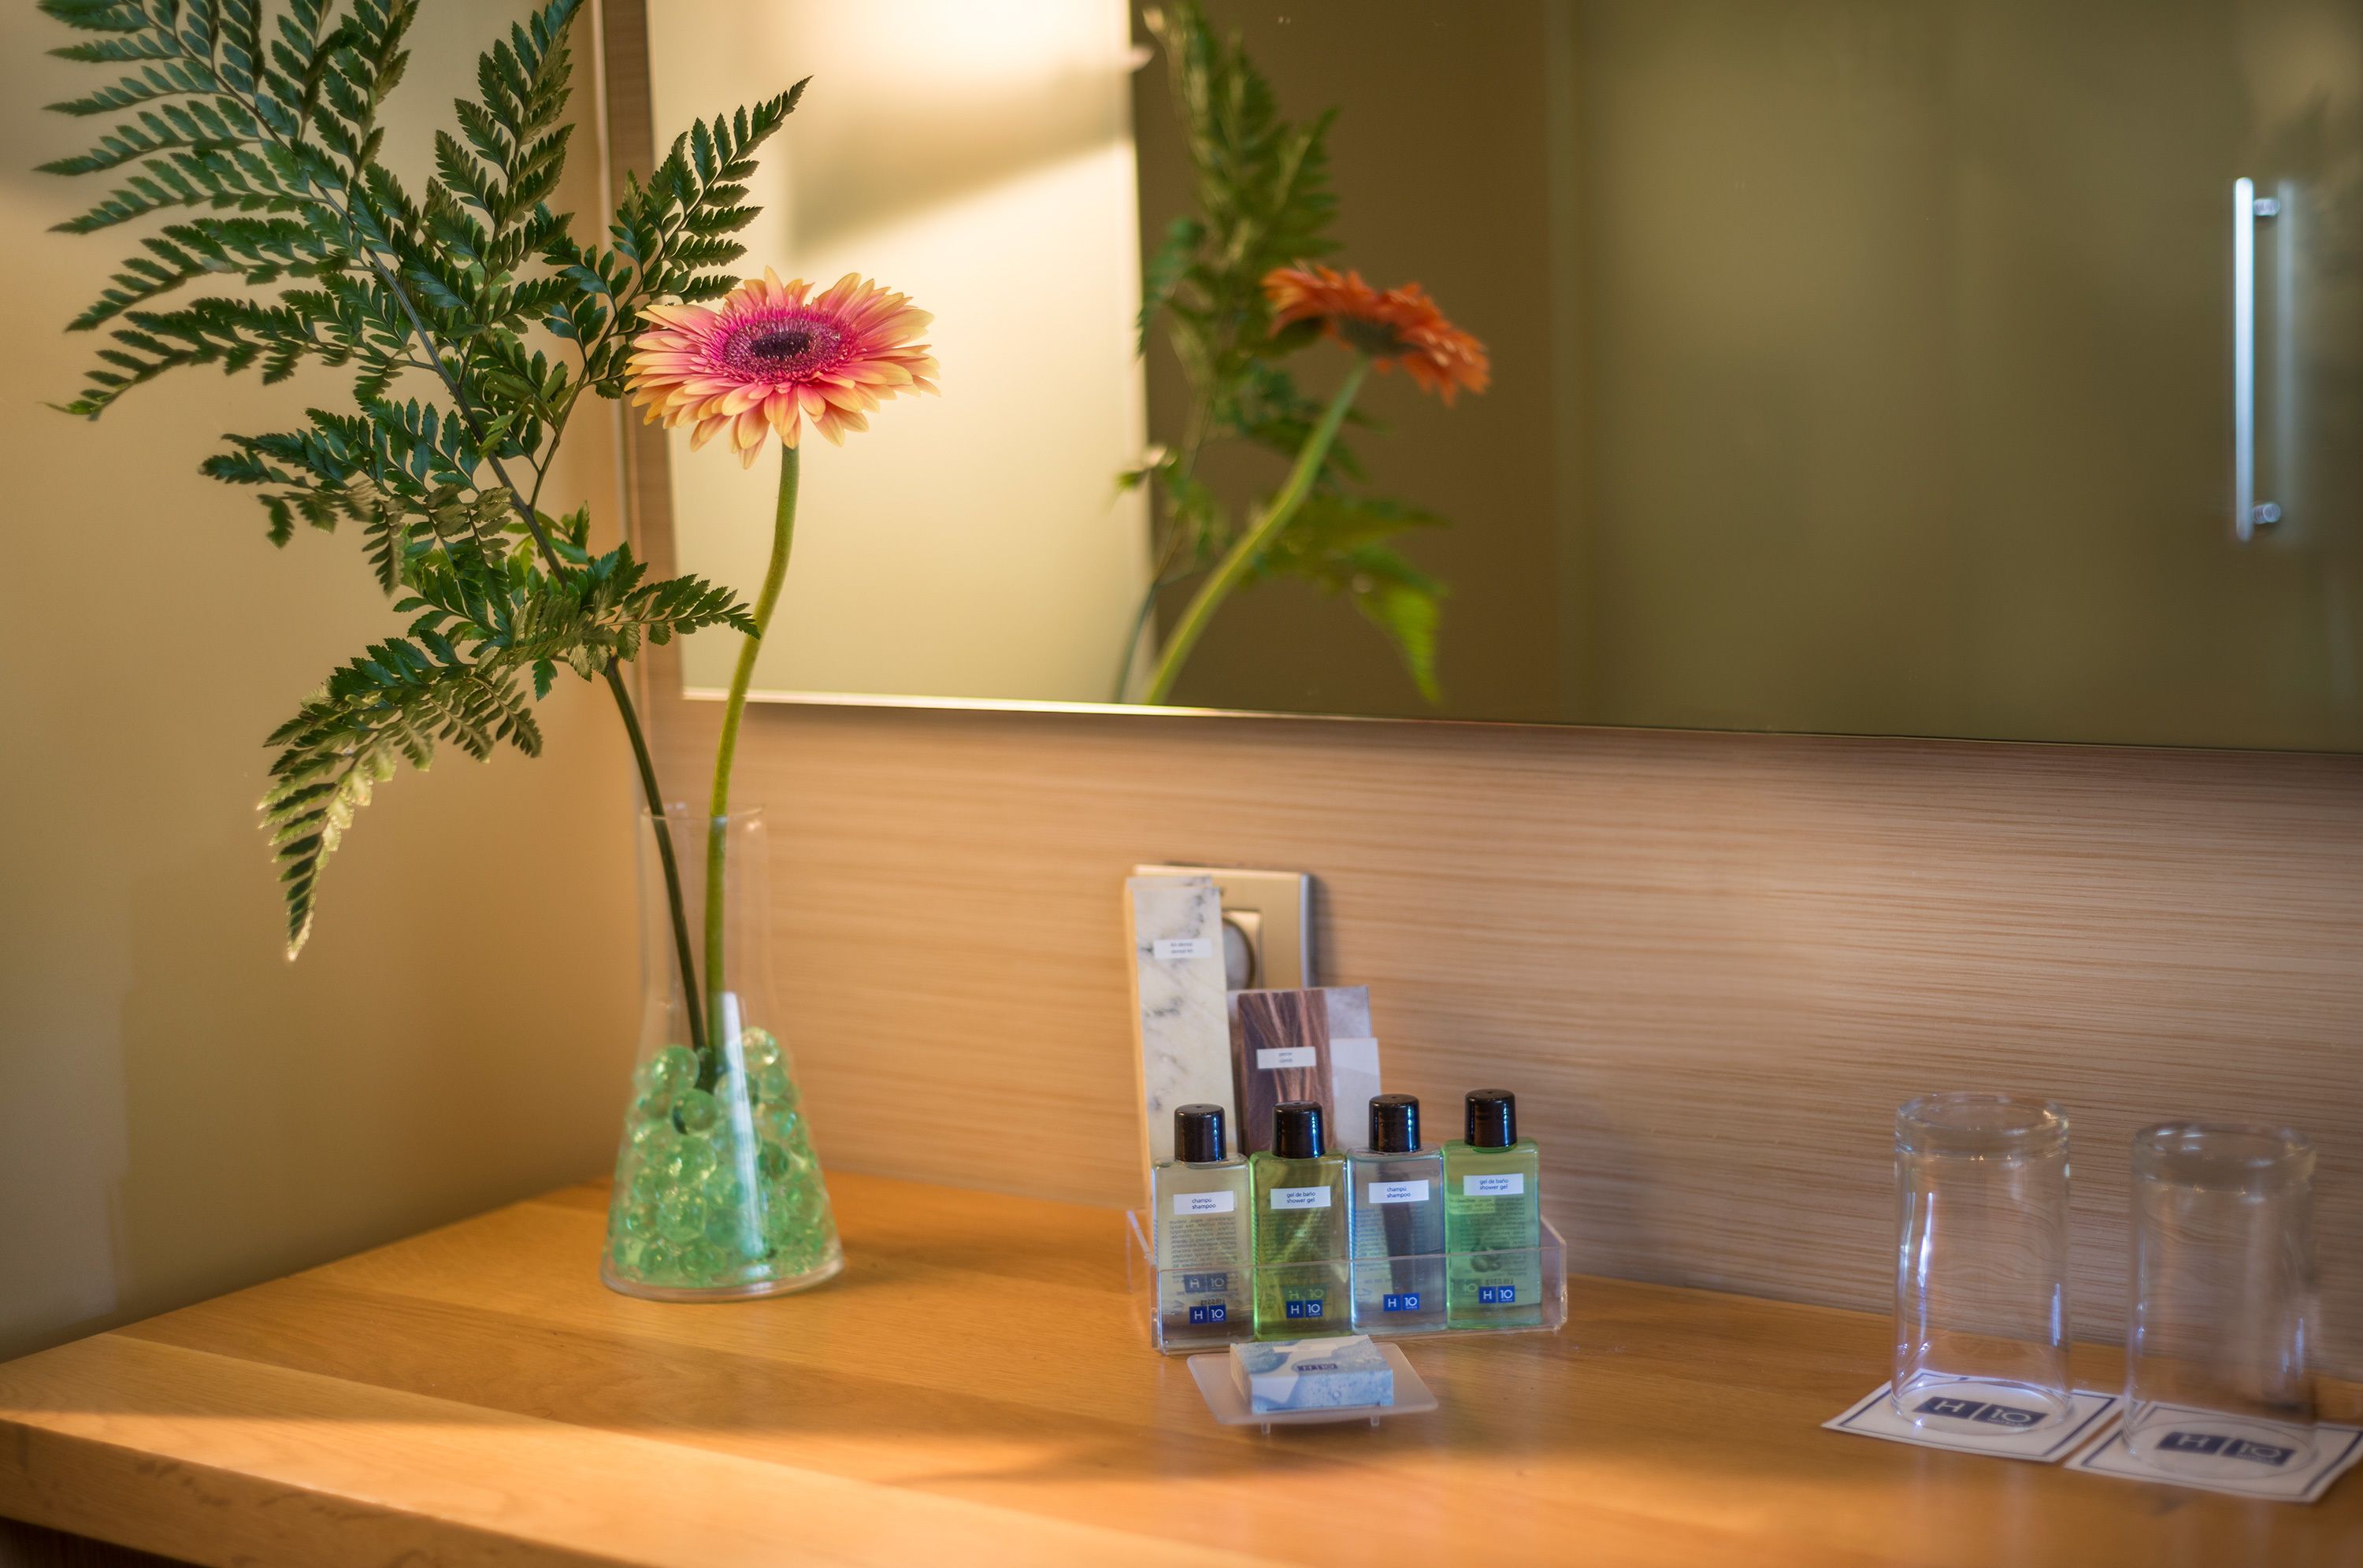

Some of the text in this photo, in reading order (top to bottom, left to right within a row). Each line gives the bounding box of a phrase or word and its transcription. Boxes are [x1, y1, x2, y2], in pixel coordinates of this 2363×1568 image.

[1482, 1289, 1513, 1300] H 10
[1387, 1296, 1418, 1308] H 10
[1194, 1308, 1224, 1320] H 10
[1290, 1303, 1321, 1314] H 10
[1934, 1400, 2032, 1423] H 10
[2176, 1435, 2211, 1448] H
